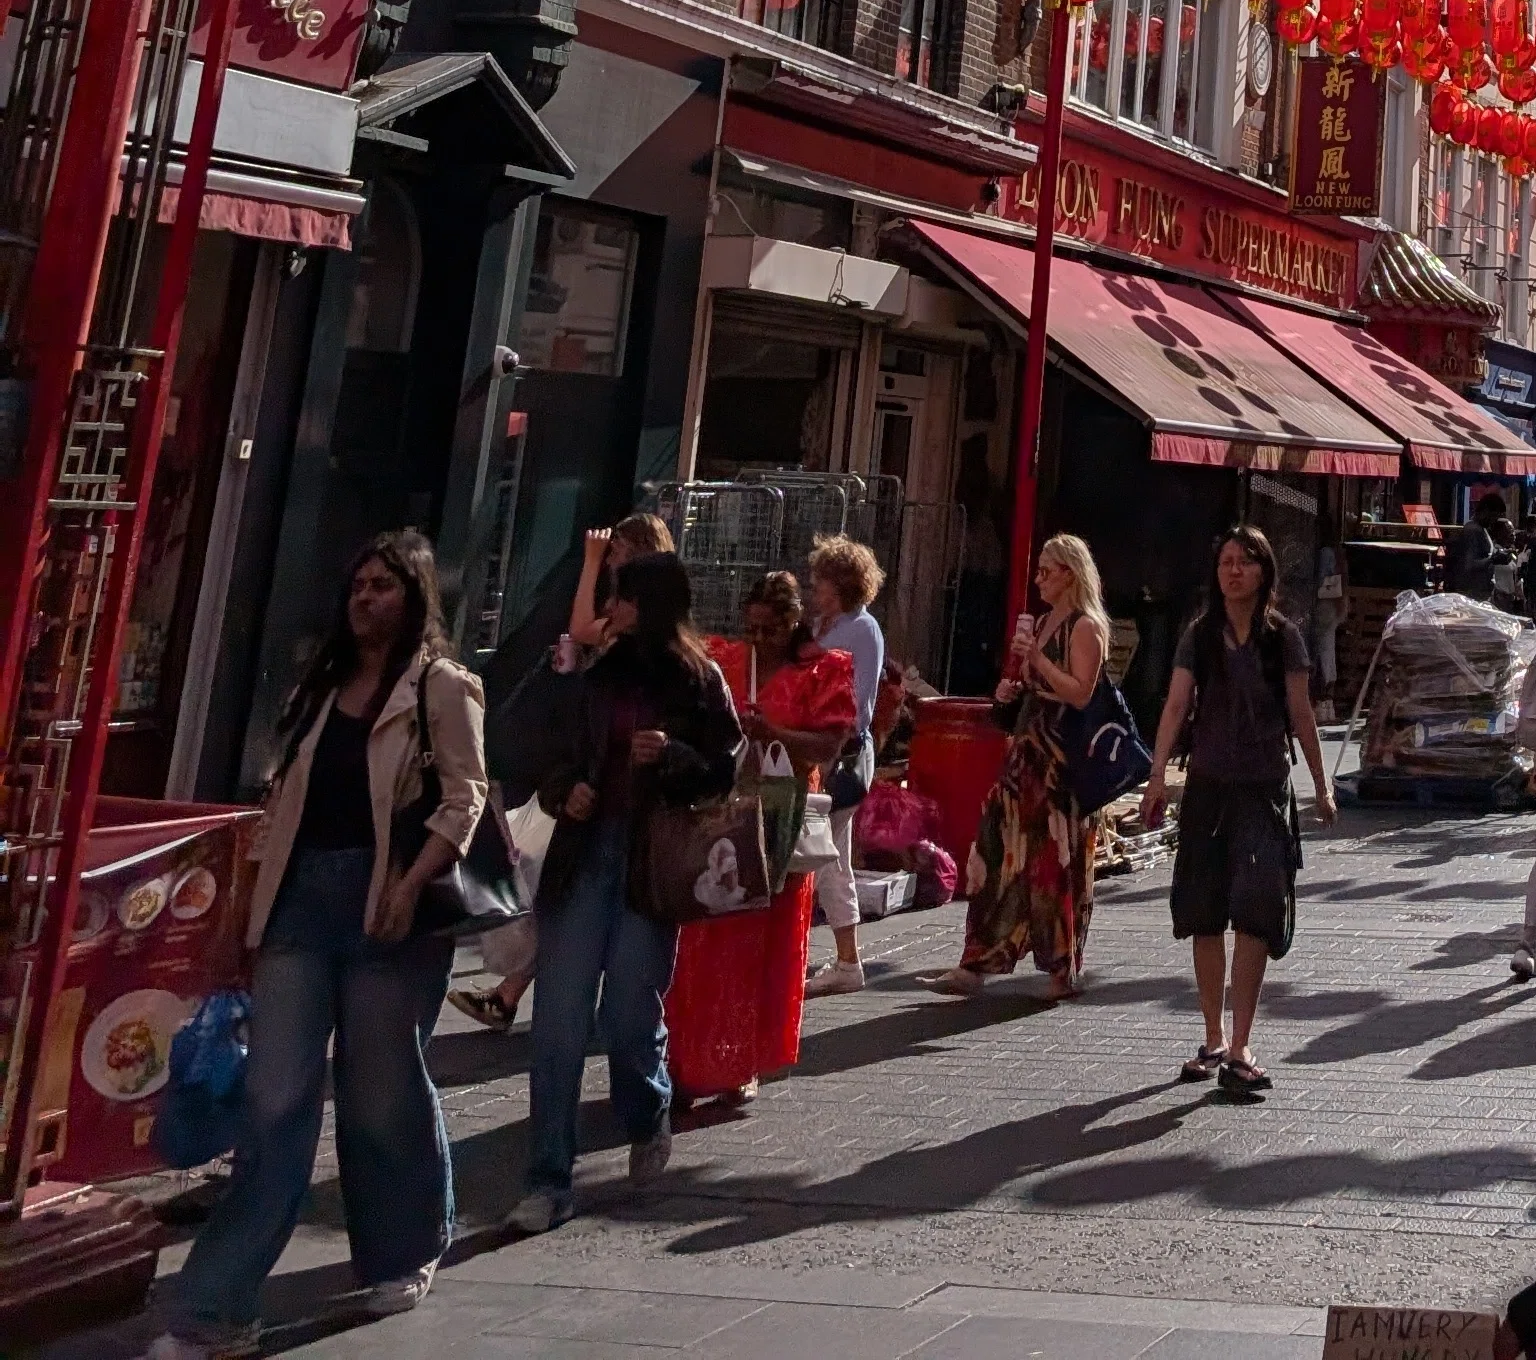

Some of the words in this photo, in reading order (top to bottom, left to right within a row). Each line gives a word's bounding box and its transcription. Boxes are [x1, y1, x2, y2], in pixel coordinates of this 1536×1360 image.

[1318, 65, 1355, 181] 新龍鳳
[1295, 194, 1333, 209] LOON
[1336, 195, 1373, 210] FUNG
[1315, 181, 1351, 194] NEW
[1018, 158, 1099, 225] LON
[1117, 177, 1185, 251] FUNG
[1202, 204, 1350, 296] SUPERMARKET
[1331, 1308, 1349, 1344] I
[1350, 1311, 1396, 1341] AM
[1398, 1309, 1479, 1341] VERY
